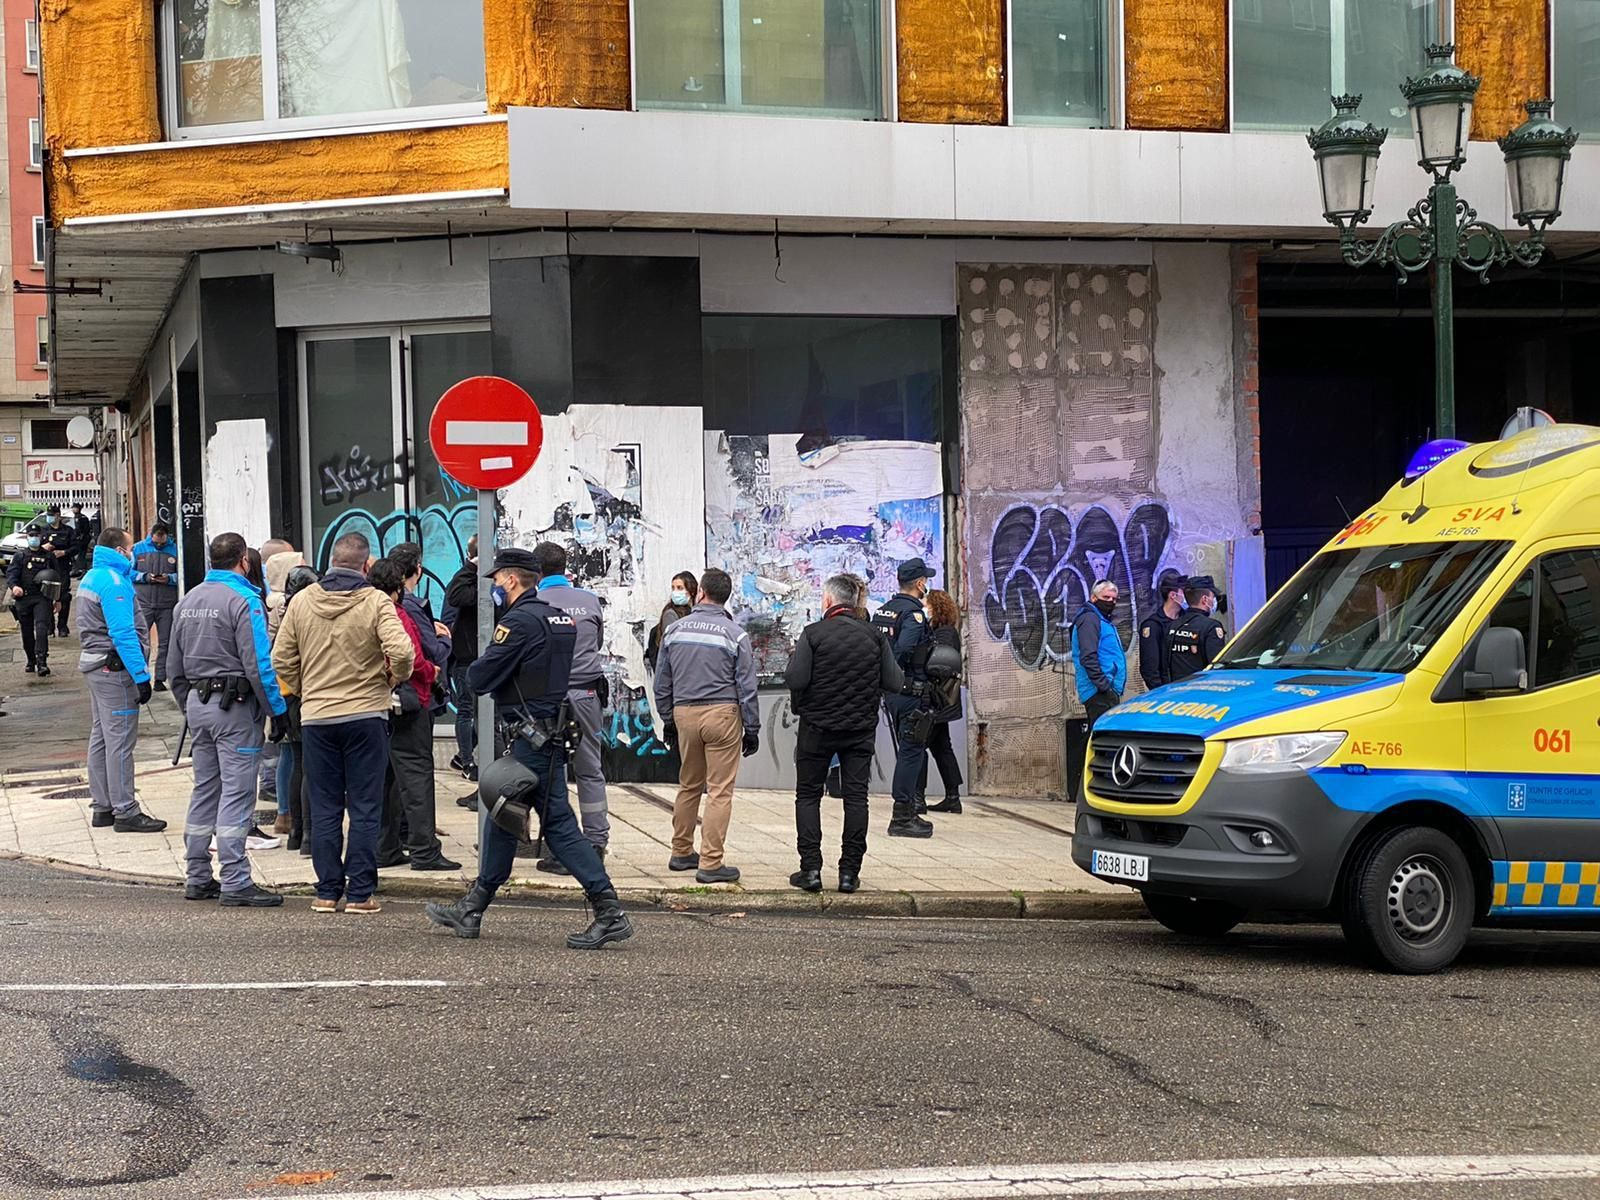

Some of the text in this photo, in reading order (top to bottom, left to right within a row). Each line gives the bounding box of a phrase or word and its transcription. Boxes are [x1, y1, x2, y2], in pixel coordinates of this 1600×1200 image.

[1452, 507, 1506, 523] SVA
[1435, 527, 1480, 537] AE-766
[678, 621, 727, 633] SECURITAS
[1534, 728, 1571, 753] 061
[1351, 741, 1403, 756] AE-766
[1097, 854, 1145, 877] 6638 LBJ
